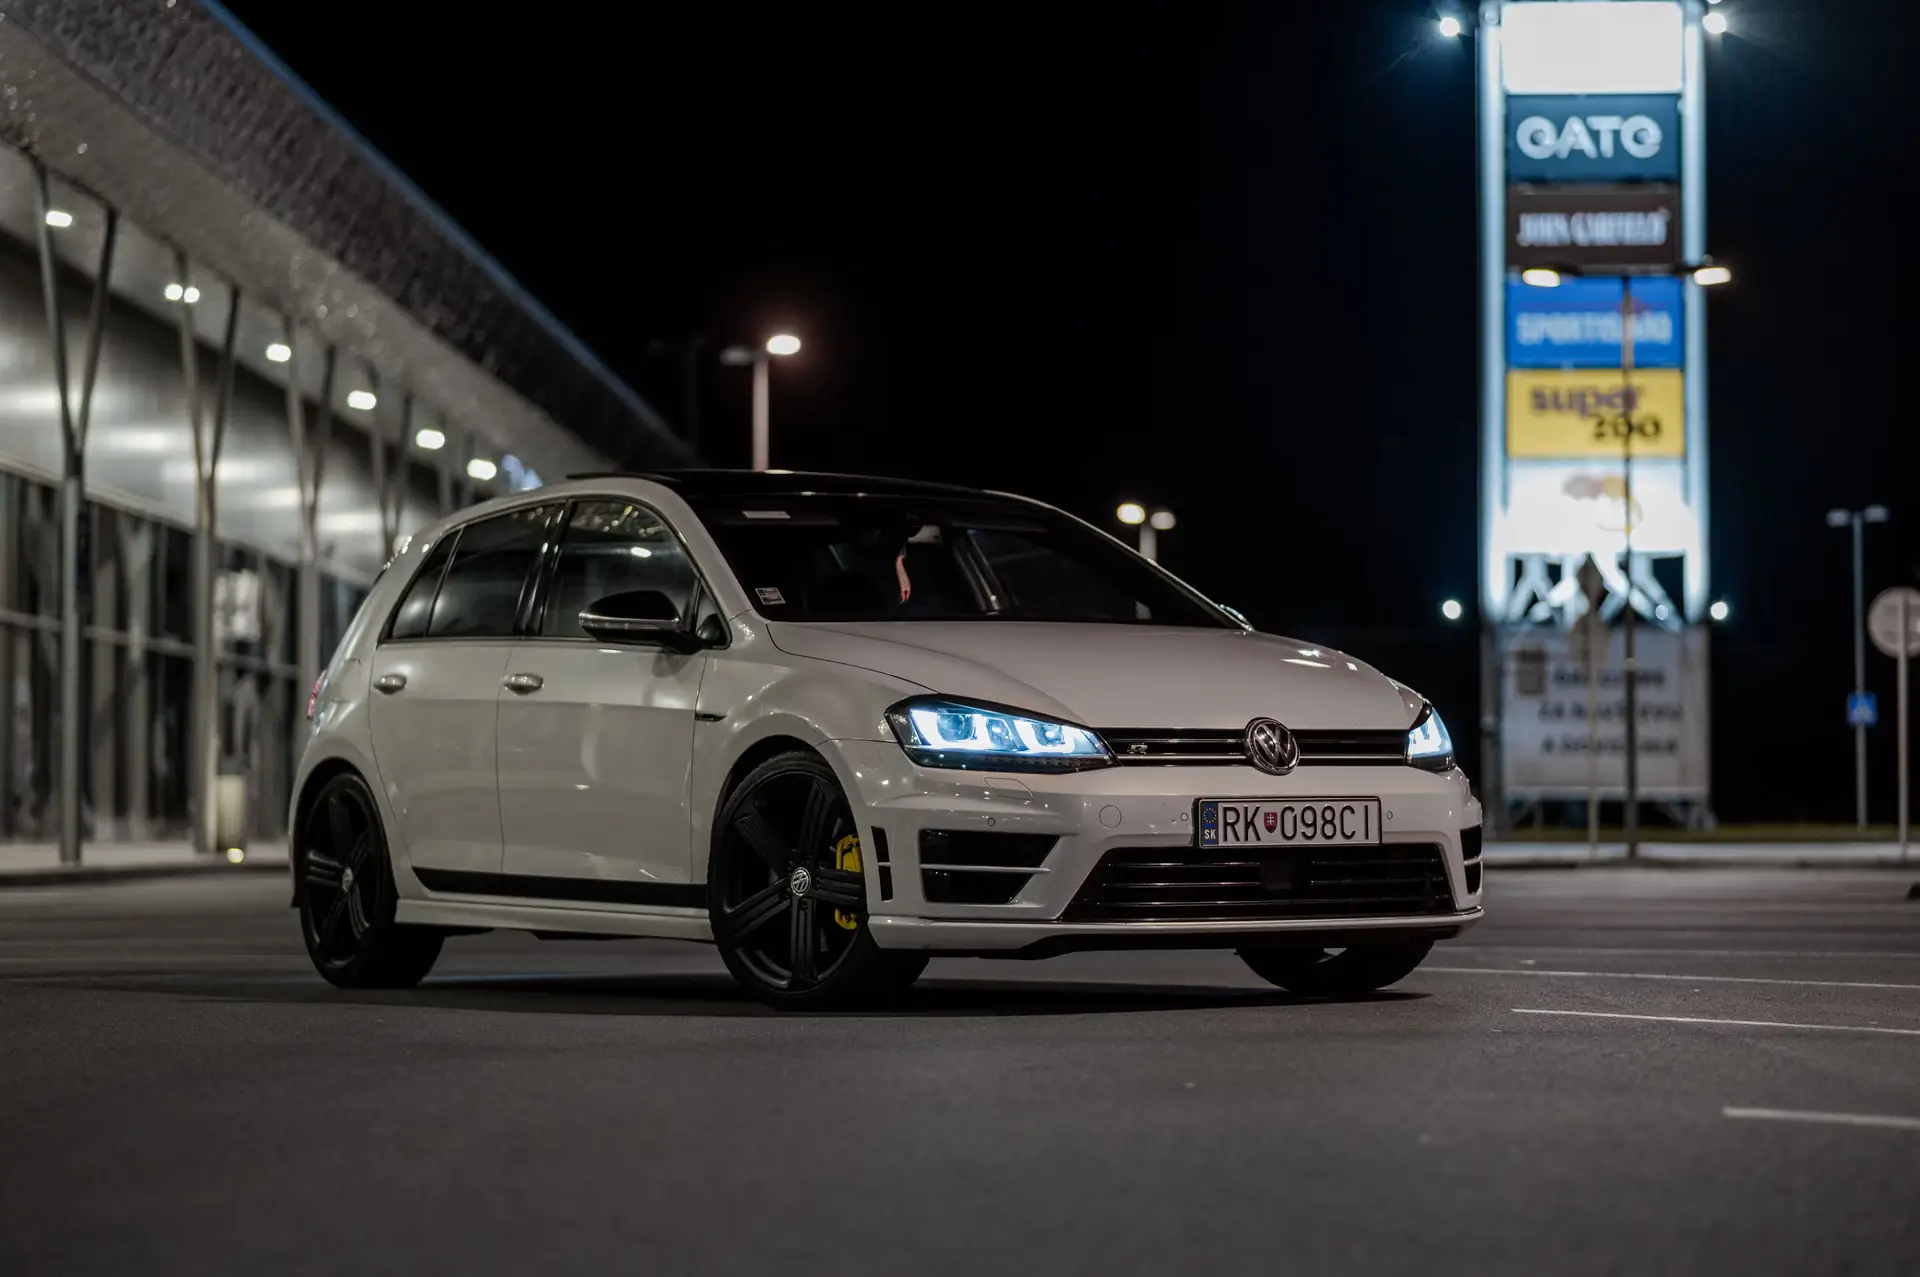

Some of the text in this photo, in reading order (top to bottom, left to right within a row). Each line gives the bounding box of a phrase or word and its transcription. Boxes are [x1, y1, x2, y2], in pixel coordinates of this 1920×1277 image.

[1204, 828, 1217, 840] SK
[1222, 804, 1370, 842] RK 098CI
